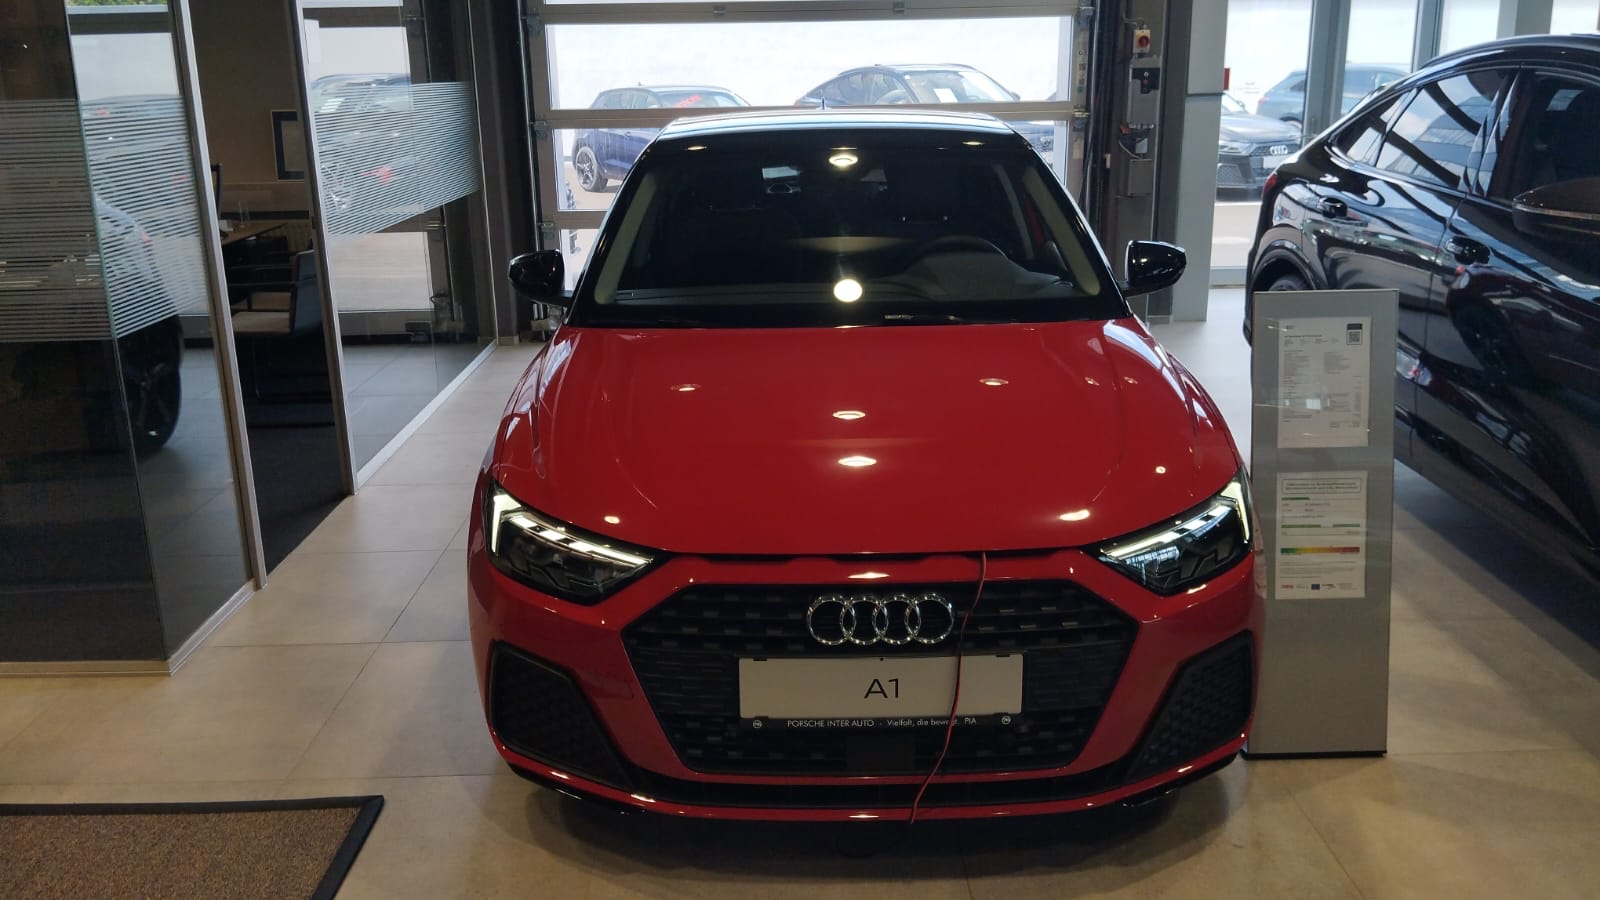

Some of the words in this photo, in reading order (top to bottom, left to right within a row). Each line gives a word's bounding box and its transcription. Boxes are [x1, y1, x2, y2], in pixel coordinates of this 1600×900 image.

[864, 678, 901, 699] A1
[787, 719, 825, 728] PORSCHE
[827, 719, 850, 728] INTER
[851, 719, 875, 728] AUTO
[887, 718, 915, 728] Vielfalt,
[917, 718, 929, 726] die
[964, 717, 977, 725] PIA
